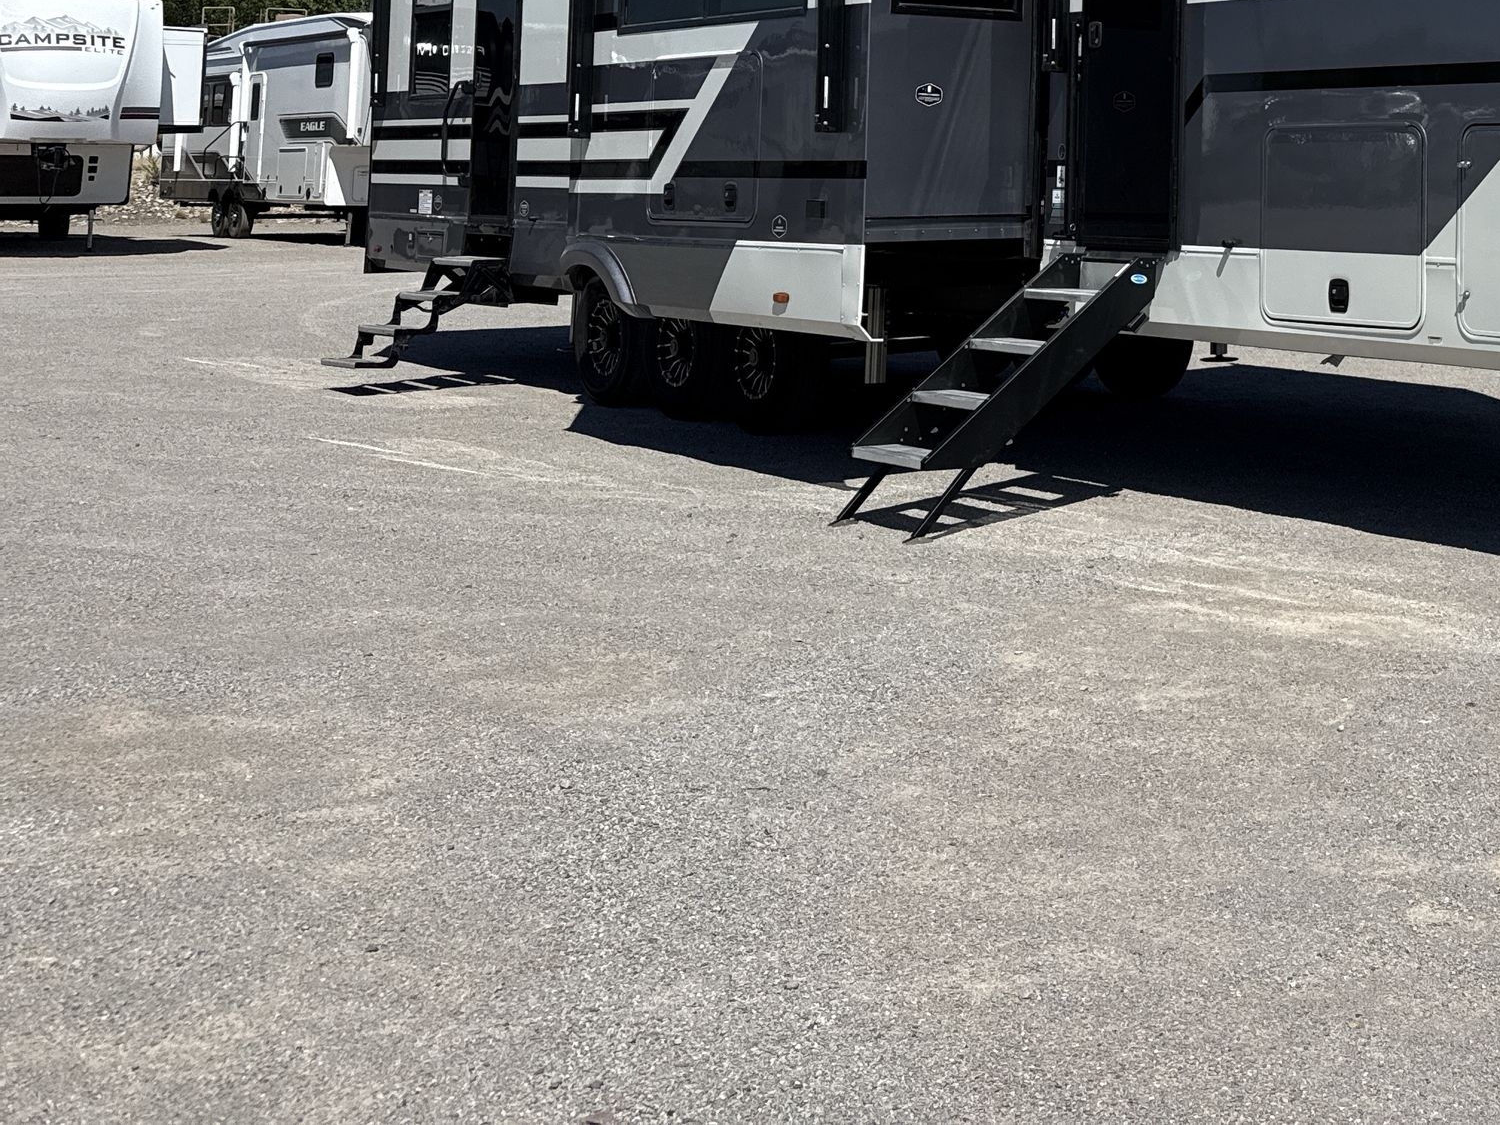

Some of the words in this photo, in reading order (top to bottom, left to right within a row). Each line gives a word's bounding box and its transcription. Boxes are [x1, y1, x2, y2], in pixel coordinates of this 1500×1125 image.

[0, 33, 126, 50] CAMPSITE
[84, 46, 124, 56] ELITE
[300, 121, 326, 132] EAGLE
